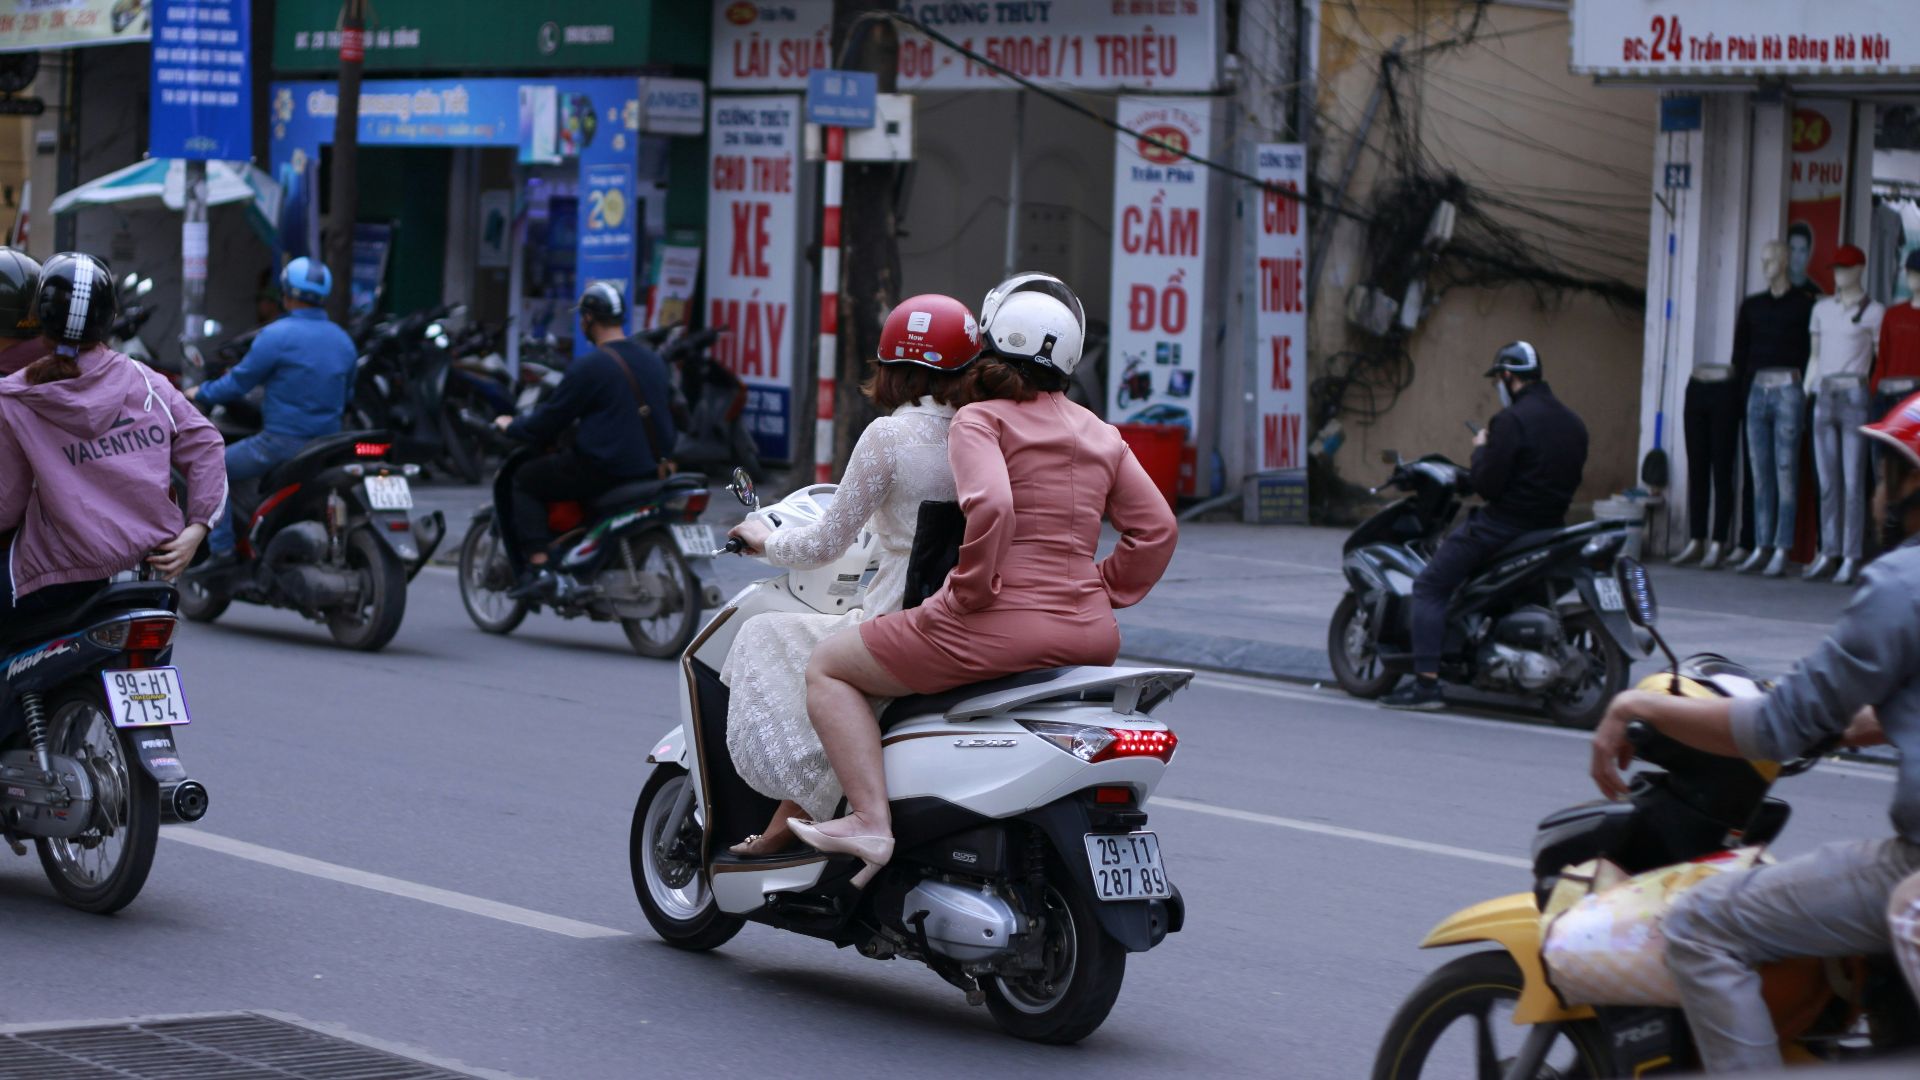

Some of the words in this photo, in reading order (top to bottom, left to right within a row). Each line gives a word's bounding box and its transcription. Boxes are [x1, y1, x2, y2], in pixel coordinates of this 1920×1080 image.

[734, 32, 770, 77] LÃI
[779, 25, 832, 77] SUẤ
[1095, 25, 1177, 87] TRIỆU
[1650, 15, 1683, 62] 24
[1762, 34, 1782, 61] Hà
[1787, 34, 1828, 63] Đông
[1834, 33, 1856, 61] Hà
[1861, 33, 1890, 66] Nội
[647, 92, 700, 111] ANKER
[714, 154, 744, 192] CHO
[1121, 189, 1199, 258] CẦM
[1263, 178, 1298, 235] CHO
[730, 201, 771, 279] XE
[1128, 268, 1189, 335] ĐỒ
[710, 288, 786, 379] MÁY
[908, 333, 924, 342] Now
[1271, 335, 1291, 391] XE
[62, 425, 166, 467] VALENTNO
[1263, 406, 1300, 469] MÁY
[114, 671, 171, 696] 99-H1
[122, 696, 178, 722] 2154
[1096, 837, 1152, 866] 29-T1
[1099, 867, 1165, 897] 287.89
